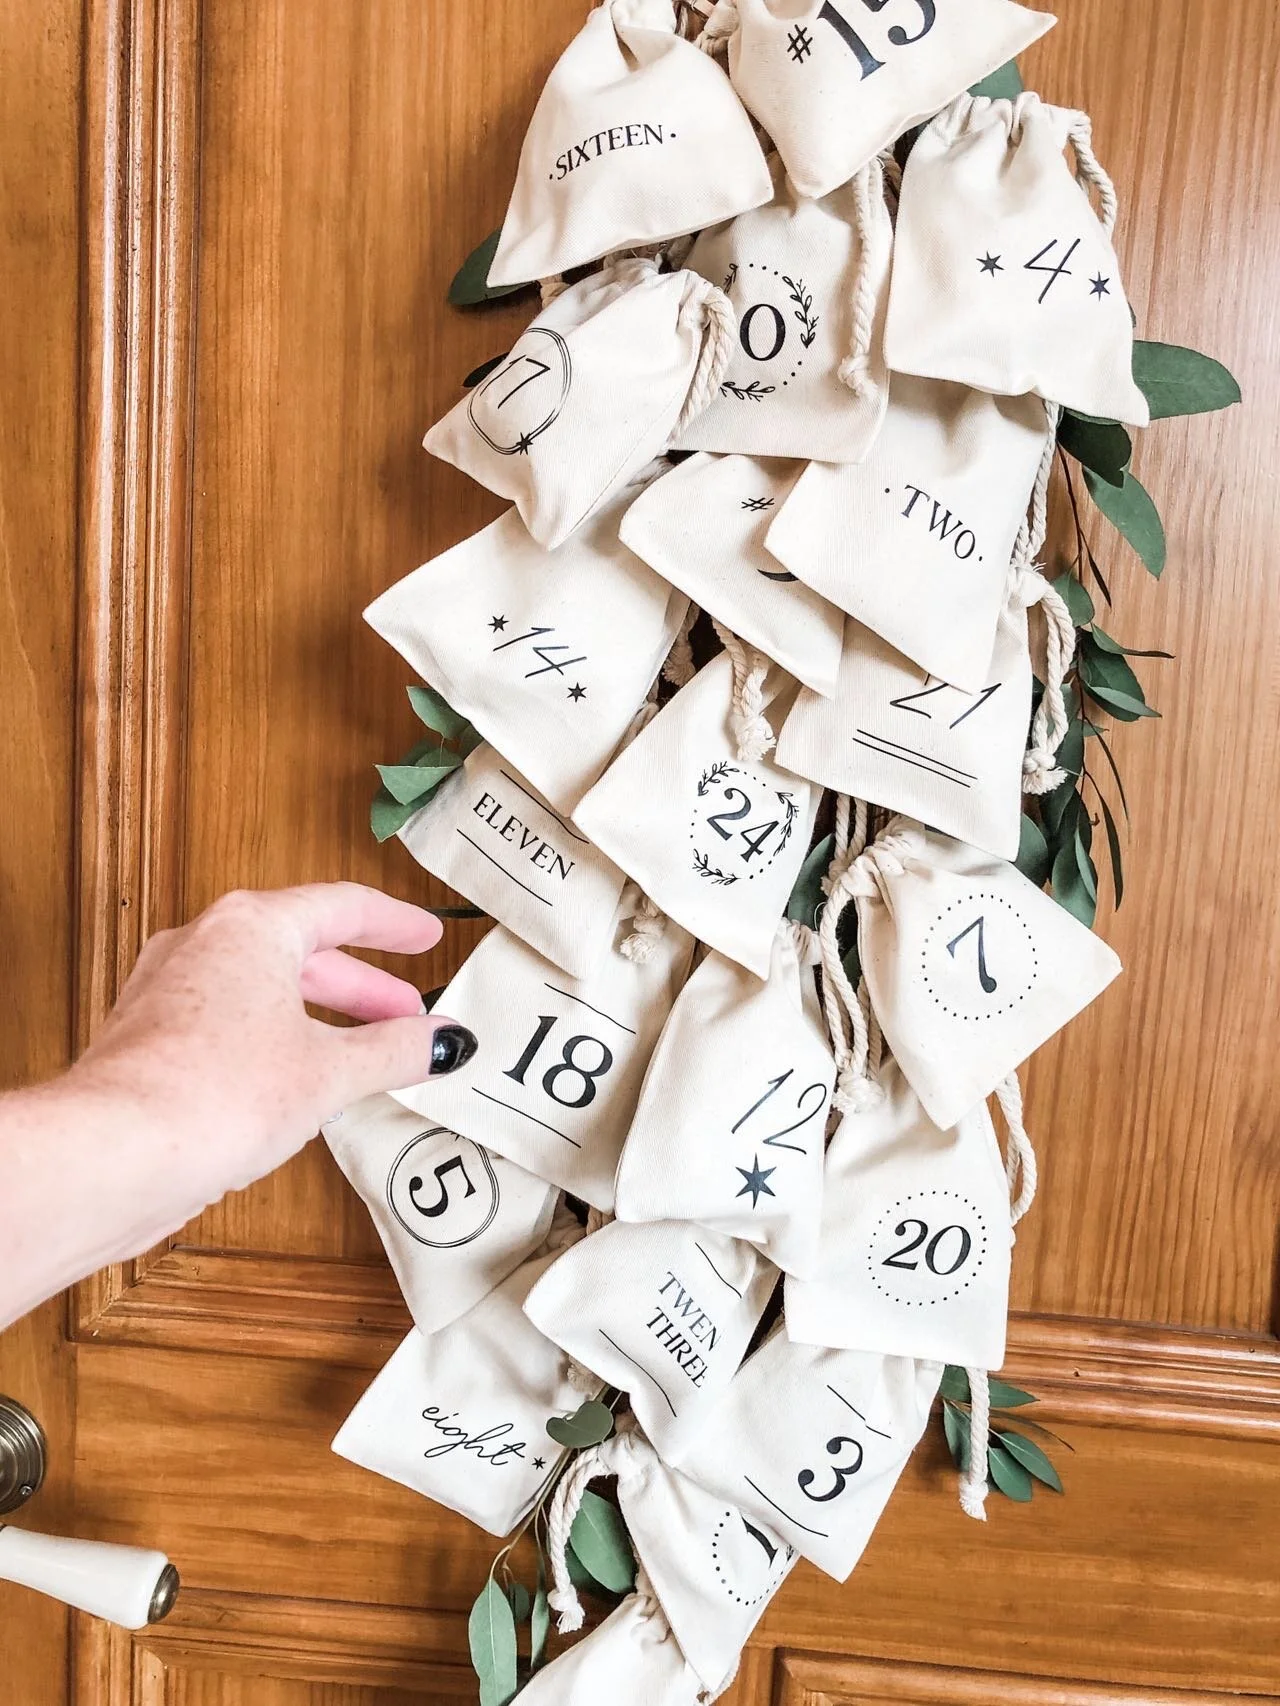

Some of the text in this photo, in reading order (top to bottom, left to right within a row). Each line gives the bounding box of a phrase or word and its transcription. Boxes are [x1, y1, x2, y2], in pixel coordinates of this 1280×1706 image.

[1023, 238, 1081, 304] 4
[492, 626, 588, 679] 14
[472, 792, 576, 881] ELEVEN
[706, 787, 780, 863] 24
[946, 916, 999, 994] 7
[502, 1015, 613, 1109] 18
[731, 1068, 828, 1156] 12
[408, 1154, 477, 1218] 5
[881, 1218, 972, 1276] 20
[421, 1404, 527, 1467] eight
[797, 1436, 864, 1503] 3
